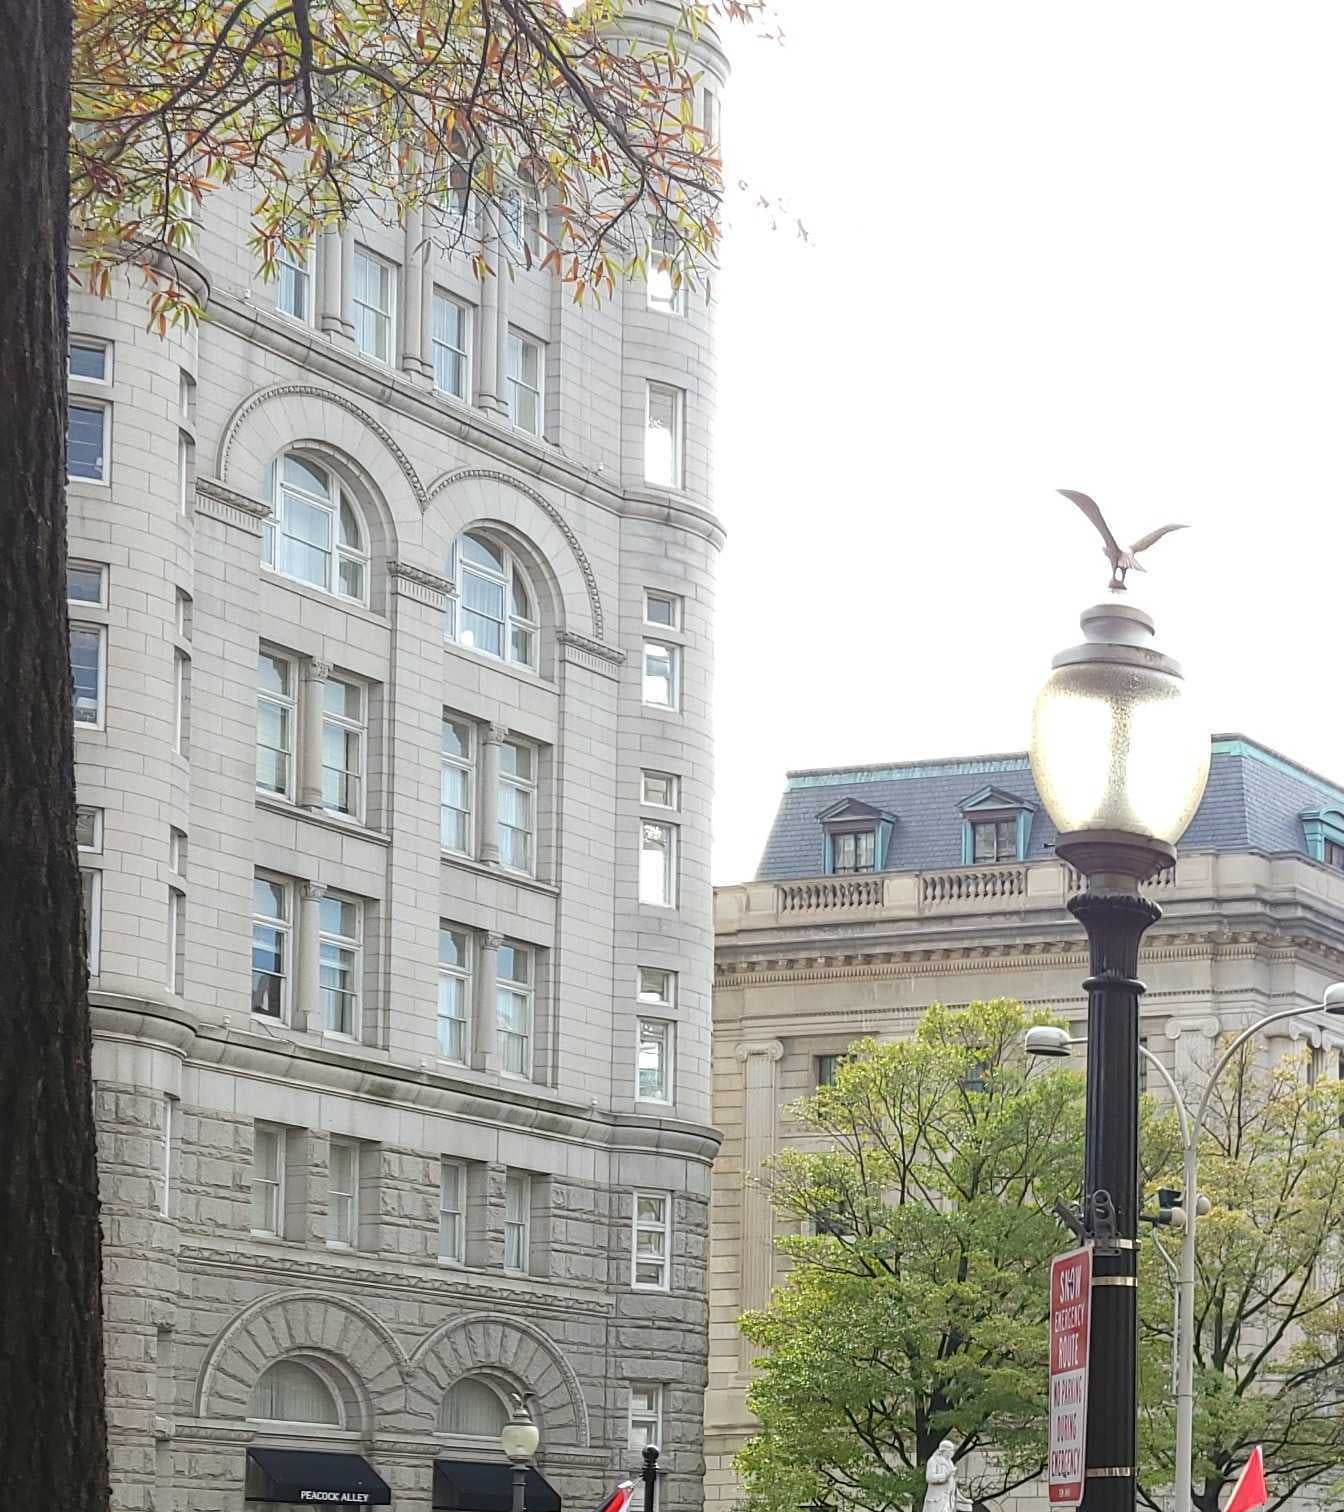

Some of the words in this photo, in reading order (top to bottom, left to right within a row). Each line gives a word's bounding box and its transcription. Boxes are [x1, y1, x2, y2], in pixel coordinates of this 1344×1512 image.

[1060, 1265, 1082, 1304] SNOW
[1055, 1303, 1085, 1332] EMERGENCY
[1058, 1333, 1079, 1369] ROUTE
[300, 1490, 340, 1502] PEACOCK
[341, 1492, 369, 1503] ALLEY
